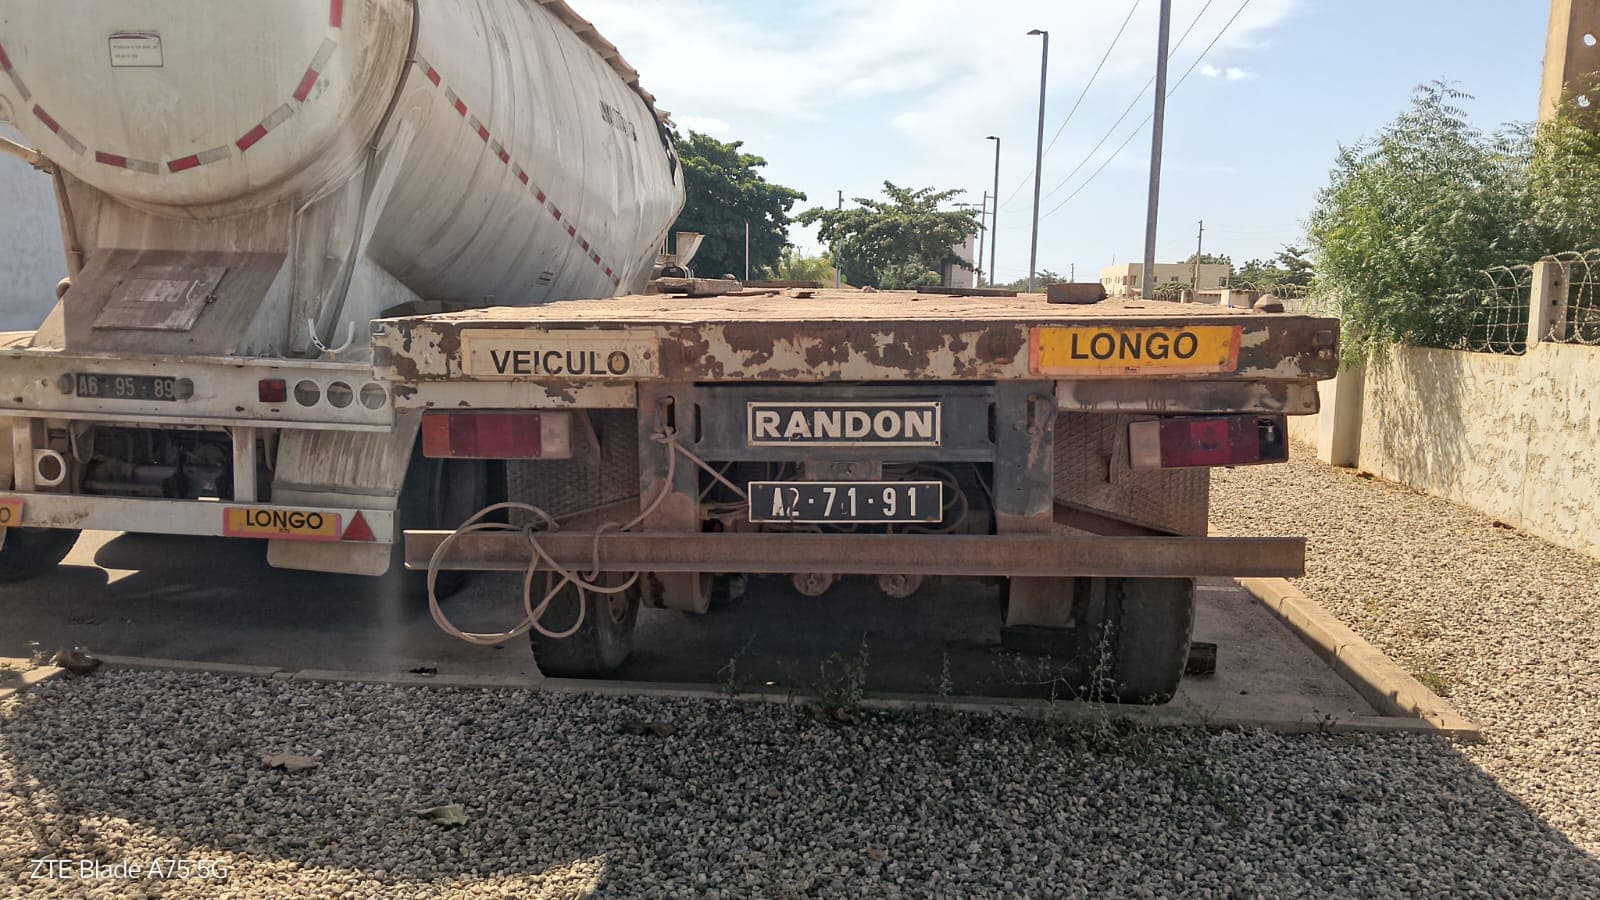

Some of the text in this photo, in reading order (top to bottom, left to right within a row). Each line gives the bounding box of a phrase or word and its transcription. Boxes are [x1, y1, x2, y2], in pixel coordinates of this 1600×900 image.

[1071, 332, 1198, 360] LONGO
[490, 350, 631, 375] VEICULO
[755, 410, 933, 438] RANDON
[246, 509, 323, 529] LONGO
